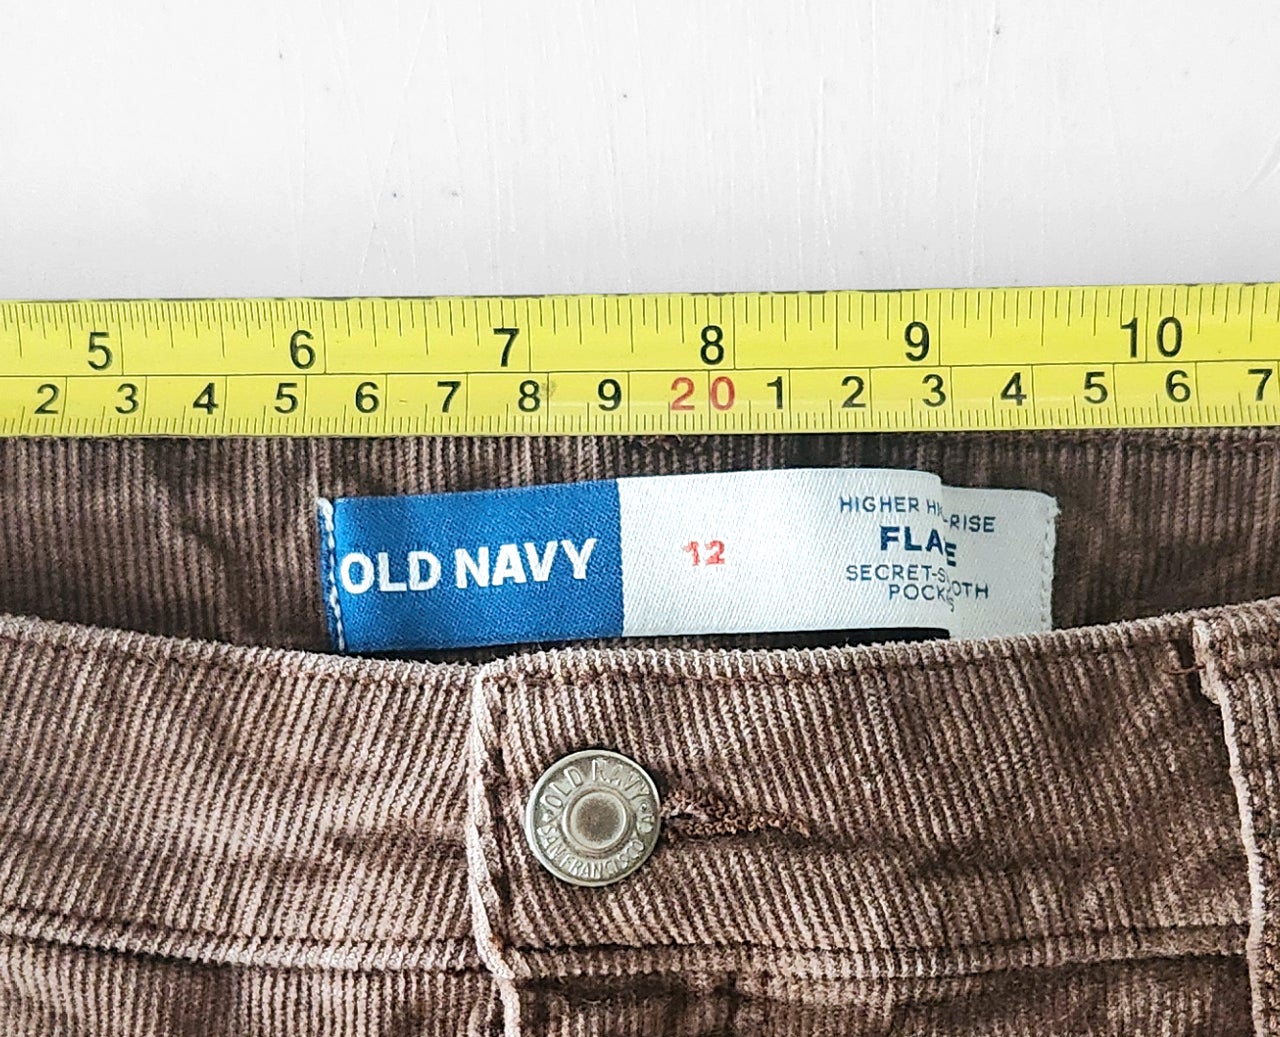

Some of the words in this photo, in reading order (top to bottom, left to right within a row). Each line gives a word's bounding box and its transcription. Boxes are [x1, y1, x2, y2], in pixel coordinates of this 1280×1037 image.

[87, 331, 112, 371] 5
[290, 329, 316, 370] 6
[493, 328, 520, 368] 7
[700, 325, 725, 366] 8
[904, 320, 930, 361] 9
[35, 384, 60, 415] 2
[115, 384, 138, 415] 3
[192, 382, 219, 415] 4
[274, 382, 298, 414] 5
[355, 382, 380, 414] 6
[436, 381, 462, 414] 7
[518, 380, 541, 413] 8
[598, 379, 622, 411] 9
[766, 375, 784, 410] 1
[840, 376, 867, 408] 2
[921, 374, 947, 407] 3
[1000, 373, 1027, 406] 4
[1083, 372, 1108, 404] 5
[1164, 369, 1191, 402] 6
[1247, 368, 1273, 400] 7
[840, 497, 919, 513] HIGHER
[340, 550, 441, 594] OLD
[454, 538, 597, 588] NAVY
[683, 540, 725, 566] 12
[880, 525, 957, 567] FLAE
[540, 766, 583, 808] OLD
